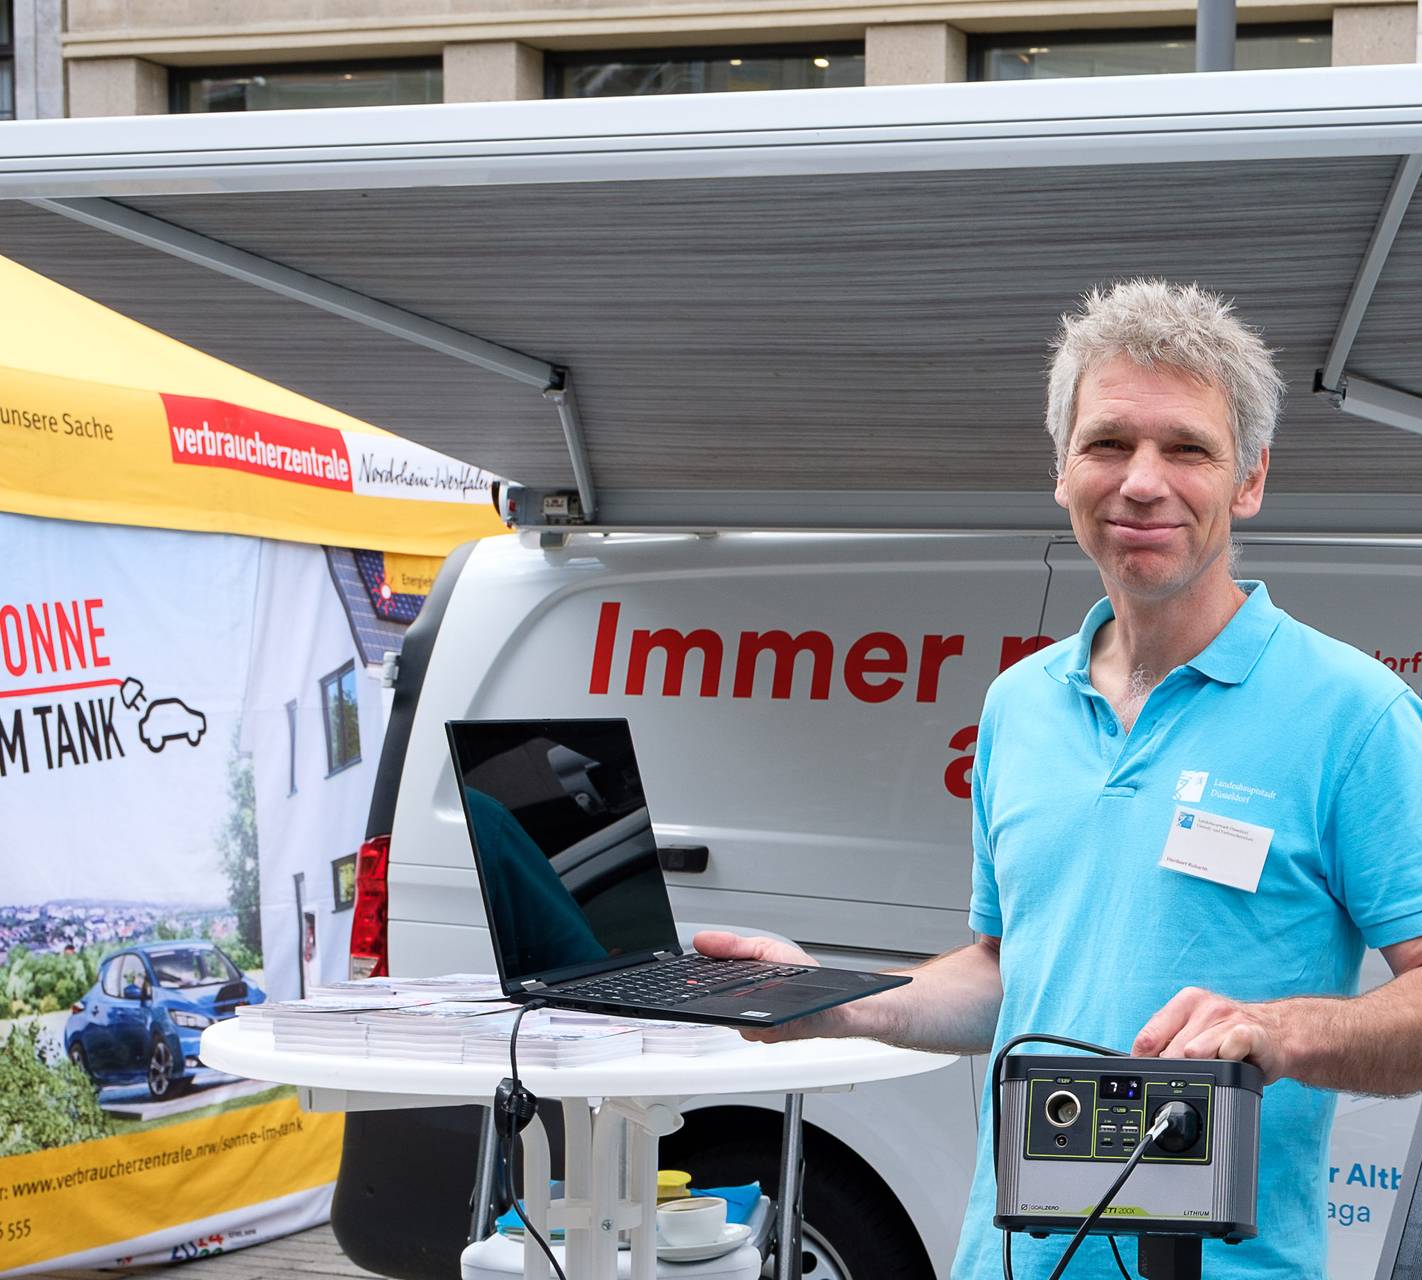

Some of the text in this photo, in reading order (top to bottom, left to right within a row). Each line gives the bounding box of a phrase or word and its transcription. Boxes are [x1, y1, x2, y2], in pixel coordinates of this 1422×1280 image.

[0, 407, 114, 440] unsere Sache
[172, 421, 350, 482] verbraucherzentrale
[589, 602, 965, 703] Immer
[1375, 650, 1422, 673] orf
[33, 697, 125, 770] TANK
[12, 1117, 304, 1198] www.verbraucherzentrale.nrw/sonne-im-tank
[8, 1219, 31, 1241] 555
